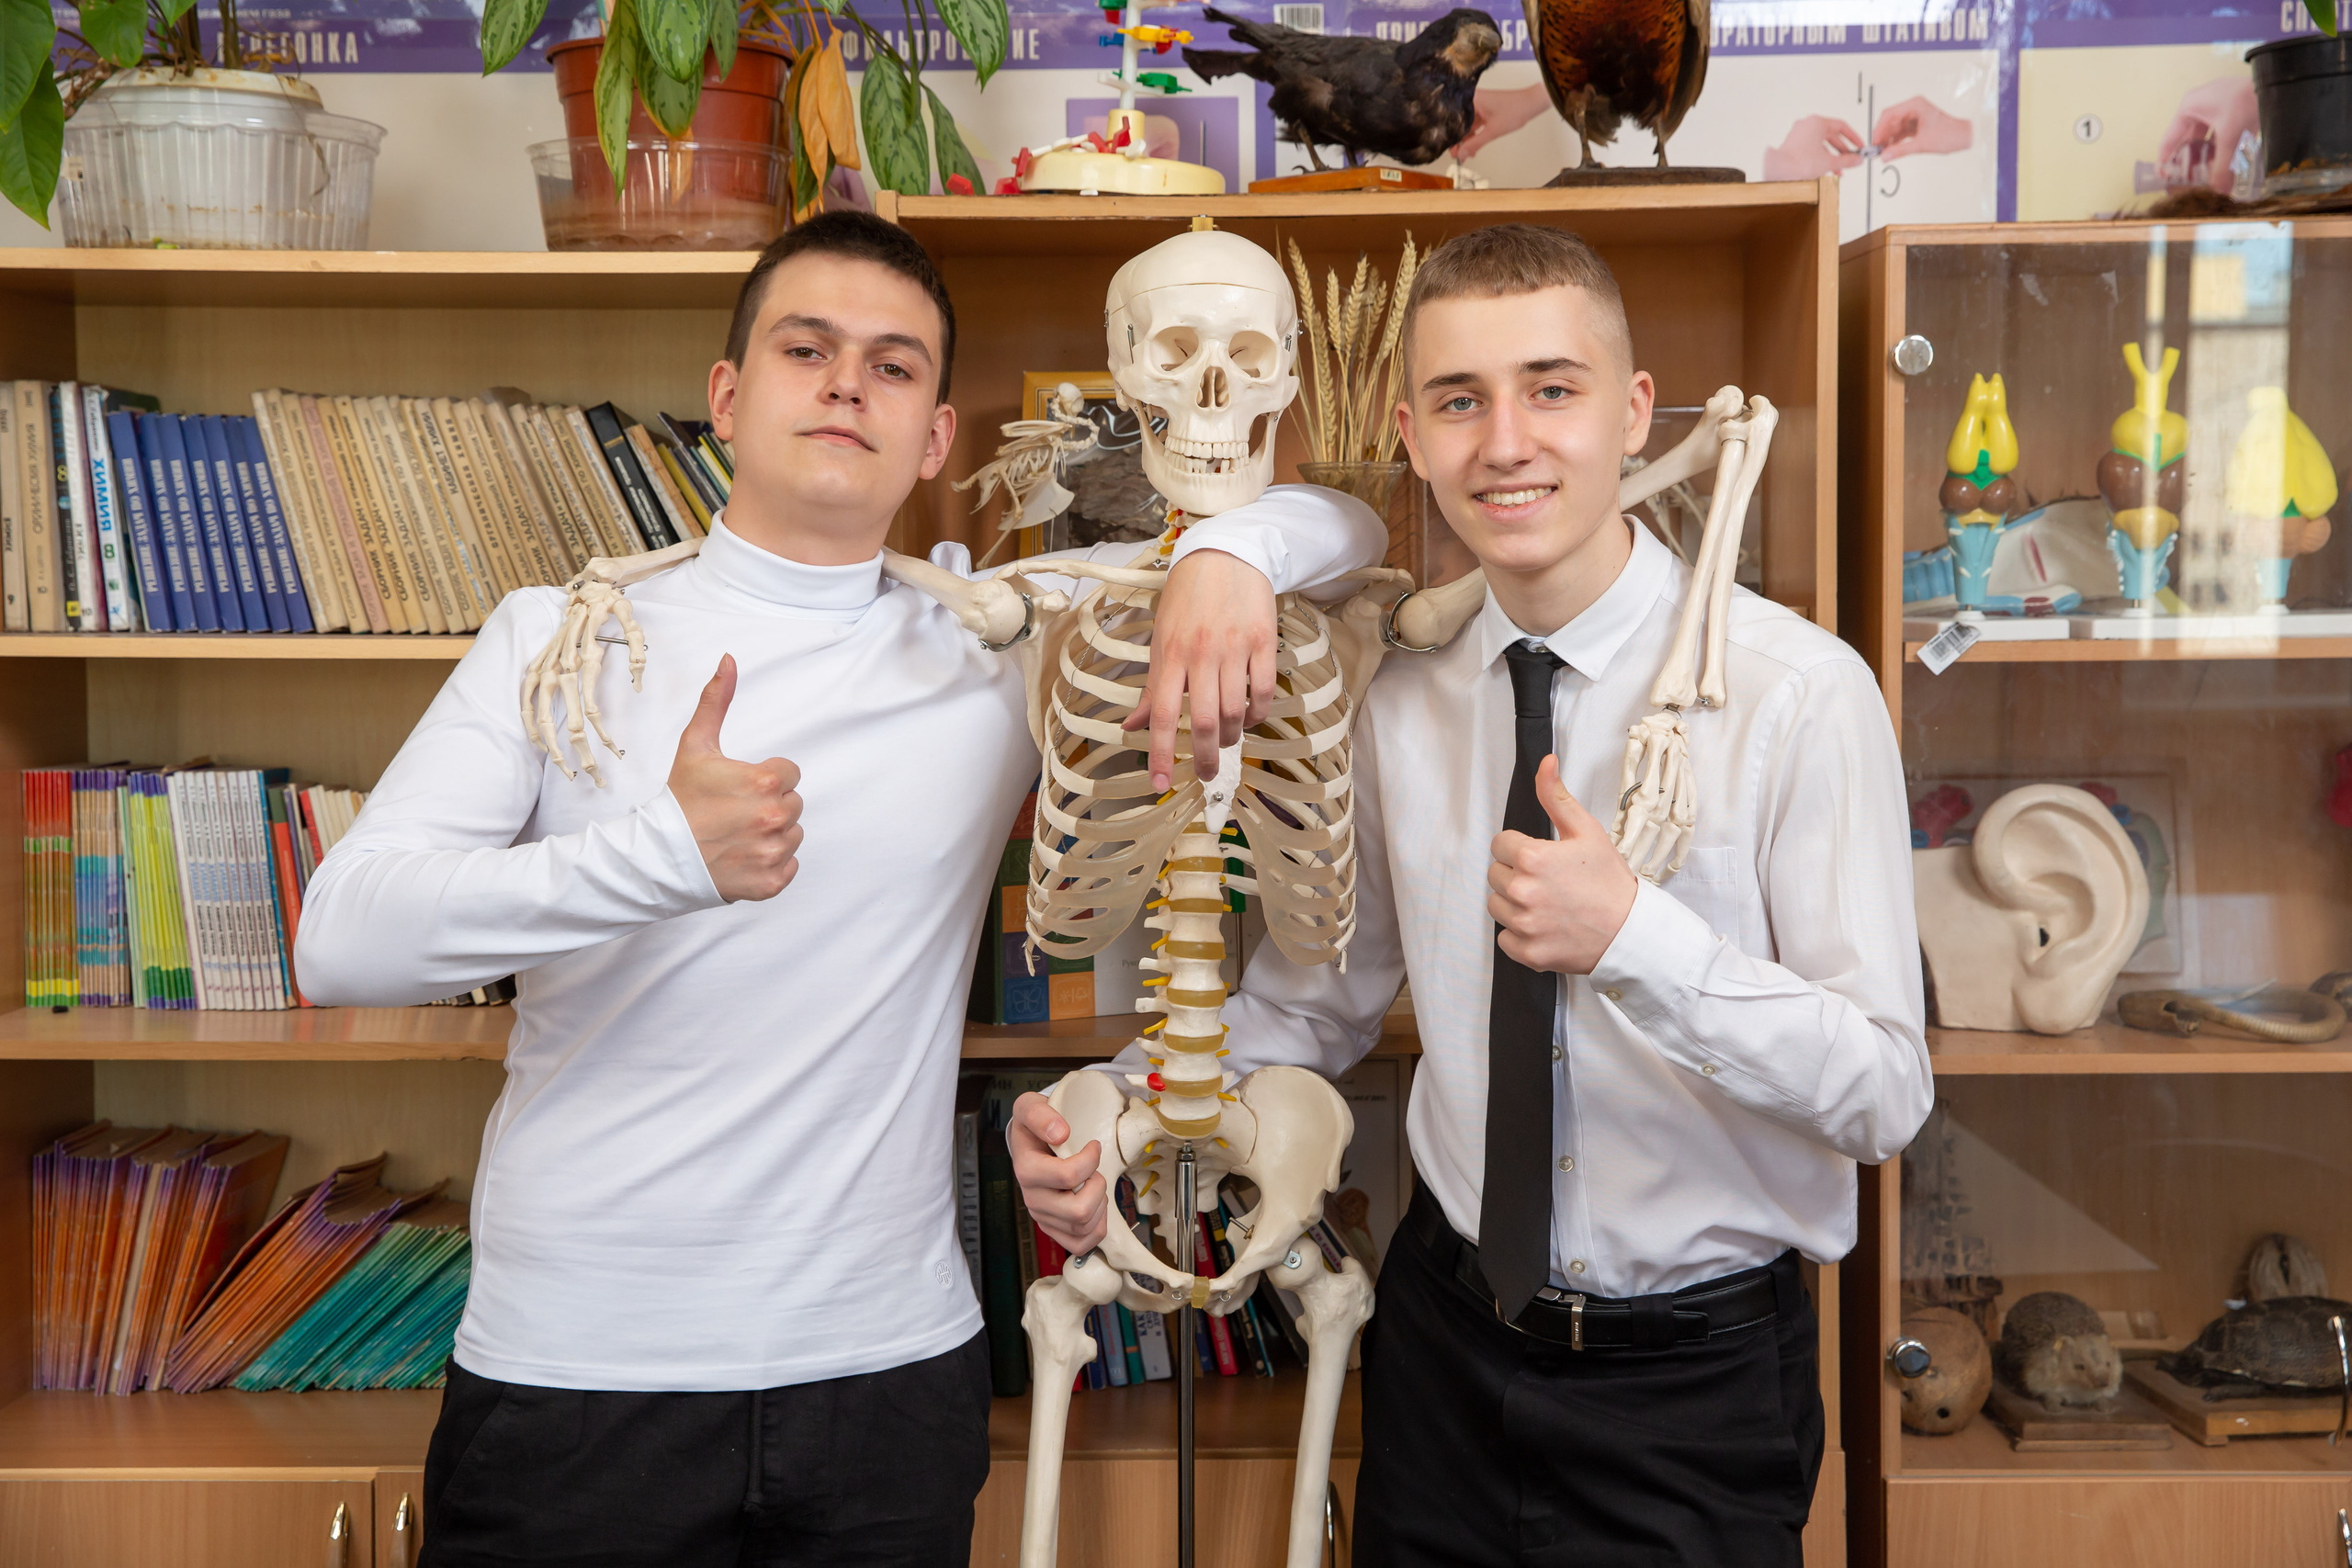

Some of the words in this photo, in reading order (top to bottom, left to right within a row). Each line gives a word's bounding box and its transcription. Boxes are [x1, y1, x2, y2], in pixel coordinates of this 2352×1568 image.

[1862, 7, 1989, 43] ШТАТИВОМ
[2082, 120, 2092, 137] 1
[420, 410, 440, 446] ХИМИИ
[444, 416, 465, 458] ХИМИЯ
[57, 465, 67, 481] 8
[121, 457, 139, 494] ХИМИИ
[150, 458, 167, 495] ХИМИИ
[169, 458, 187, 495] ХИМИИ
[192, 458, 210, 496] ХИМИИ
[214, 459, 232, 496] ХИМИИ
[235, 460, 254, 498] ХИМИИ
[254, 461, 273, 498] ХИМИИ
[435, 449, 459, 495] КАБИНЕТ
[92, 457, 112, 531] ХИМИЯ
[129, 494, 142, 511] ПО
[157, 494, 171, 511] ПО
[176, 495, 190, 512] ПО
[200, 495, 214, 512] ПО
[222, 496, 237, 513] ПО
[243, 497, 258, 513] ПО
[263, 497, 277, 514] ПО
[461, 463, 499, 548] ОРГАНИЧЕСКАЯ
[132, 512, 150, 544] ЗАДАЧ
[160, 512, 177, 543] ЗАДАЧ
[180, 512, 198, 544] ЗАДАЧ
[204, 512, 221, 544] ЗАДАЧ
[226, 512, 244, 544] ЗАДАЧ
[248, 513, 266, 546] ЗАДАЧ
[267, 513, 287, 546] ЗАДАЧ
[355, 507, 374, 546] ЗАДАЧ
[371, 508, 390, 547] ЗАДАЧ
[392, 509, 413, 547] ЗАДАЧ
[514, 503, 536, 542] ЗАДАЧ
[534, 511, 557, 550] ЗАДАЧ
[557, 511, 580, 549] ЗАДАЧ
[104, 544, 115, 558] 8
[138, 543, 158, 592] РЕШЕНИЕ
[165, 543, 186, 592] РЕШЕНИЕ
[186, 543, 206, 592] РЕШЕНИЕ
[209, 543, 231, 592] РЕШЕНИЕ
[233, 544, 254, 592] РЕШЕНИЕ
[255, 544, 277, 593] РЕШЕНИЕ
[275, 545, 298, 594] РЕШЕНИЕ
[368, 548, 391, 600] СБОРНИК
[385, 549, 409, 602] СБОРНИК
[407, 550, 431, 602] СБОРНИК
